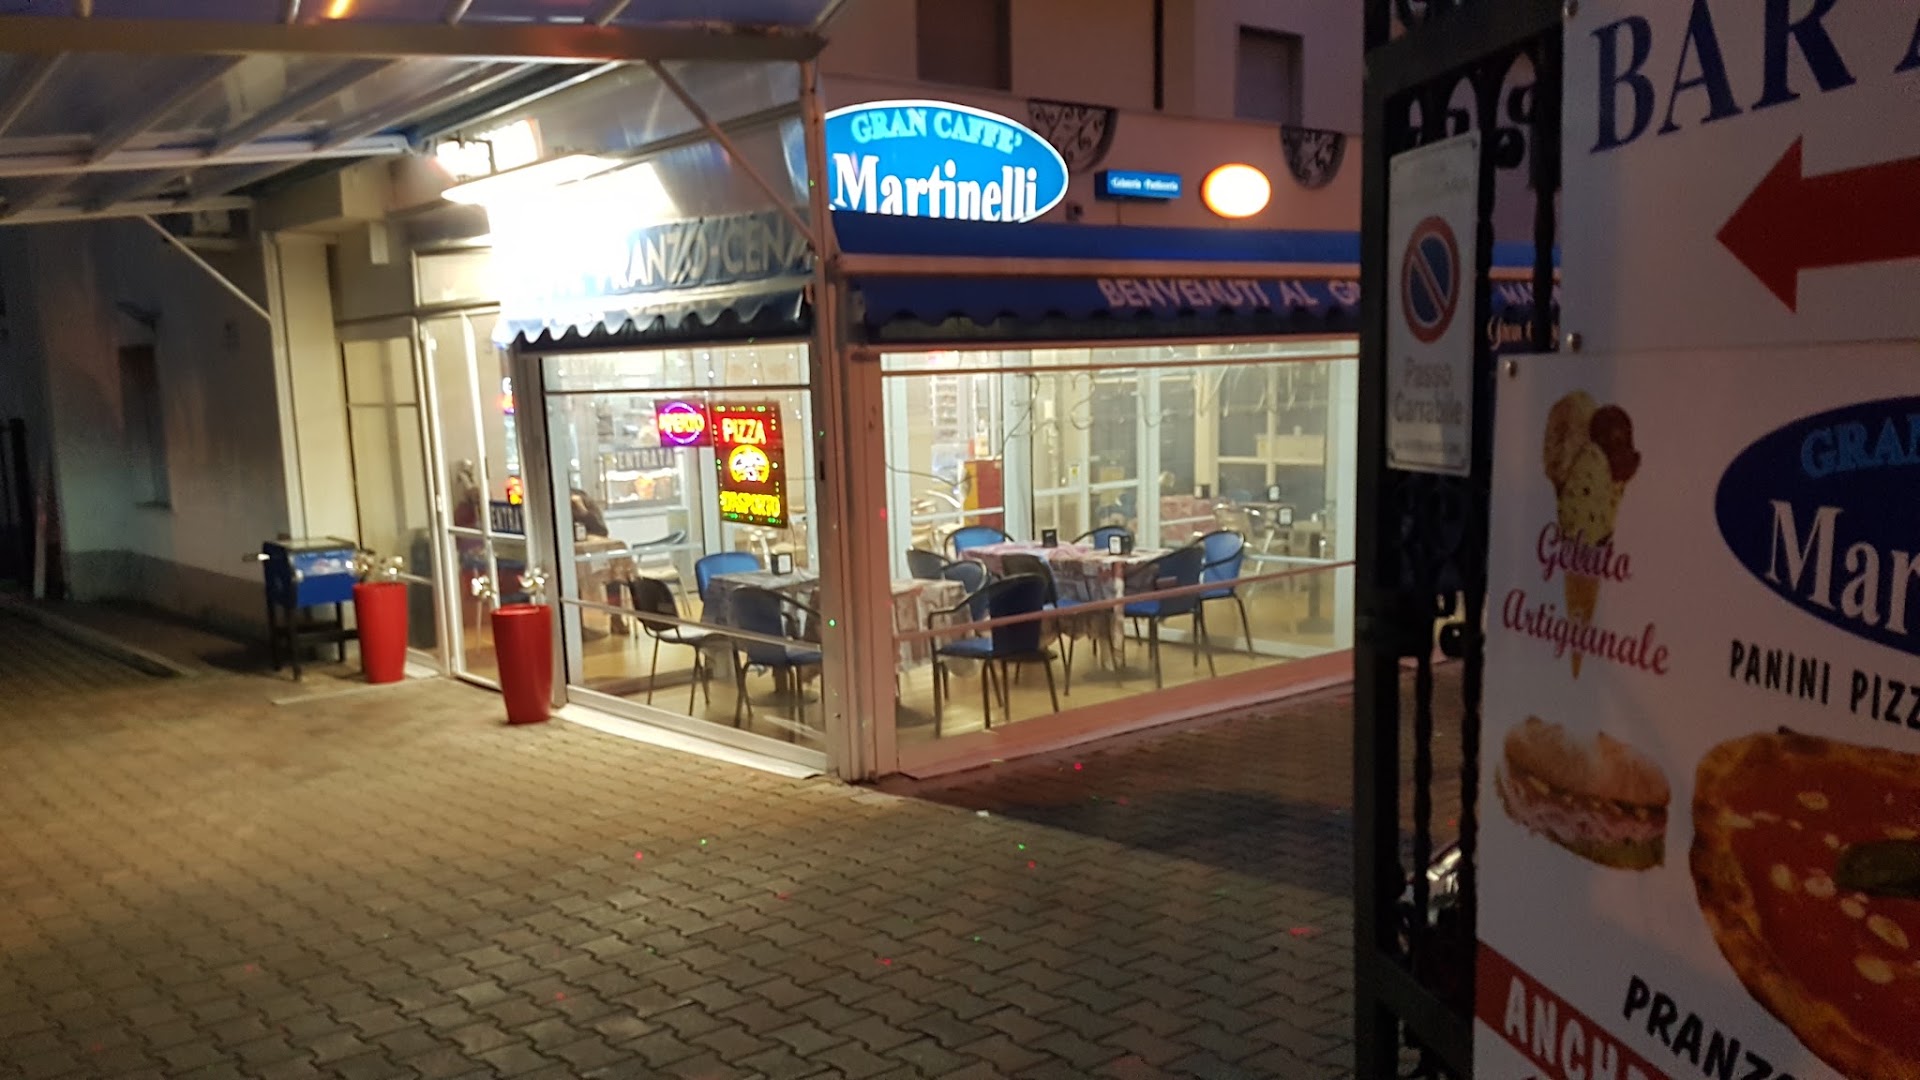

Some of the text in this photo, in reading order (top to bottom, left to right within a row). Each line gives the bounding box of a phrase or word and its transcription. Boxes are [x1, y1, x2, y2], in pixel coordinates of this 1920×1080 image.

[1590, 0, 1857, 154] BAR
[851, 107, 1023, 154] GRAN CAFFE'
[832, 153, 1038, 222] Martinelli
[1097, 278, 1270, 308] BENVENUTI
[1279, 280, 1320, 307] AL
[722, 417, 767, 445] PIZZA
[1537, 521, 1632, 582] Gelato
[1502, 588, 1669, 676] Artigianale
[1730, 640, 1830, 705] PANINI
[1623, 974, 1797, 1080] PRANZ
